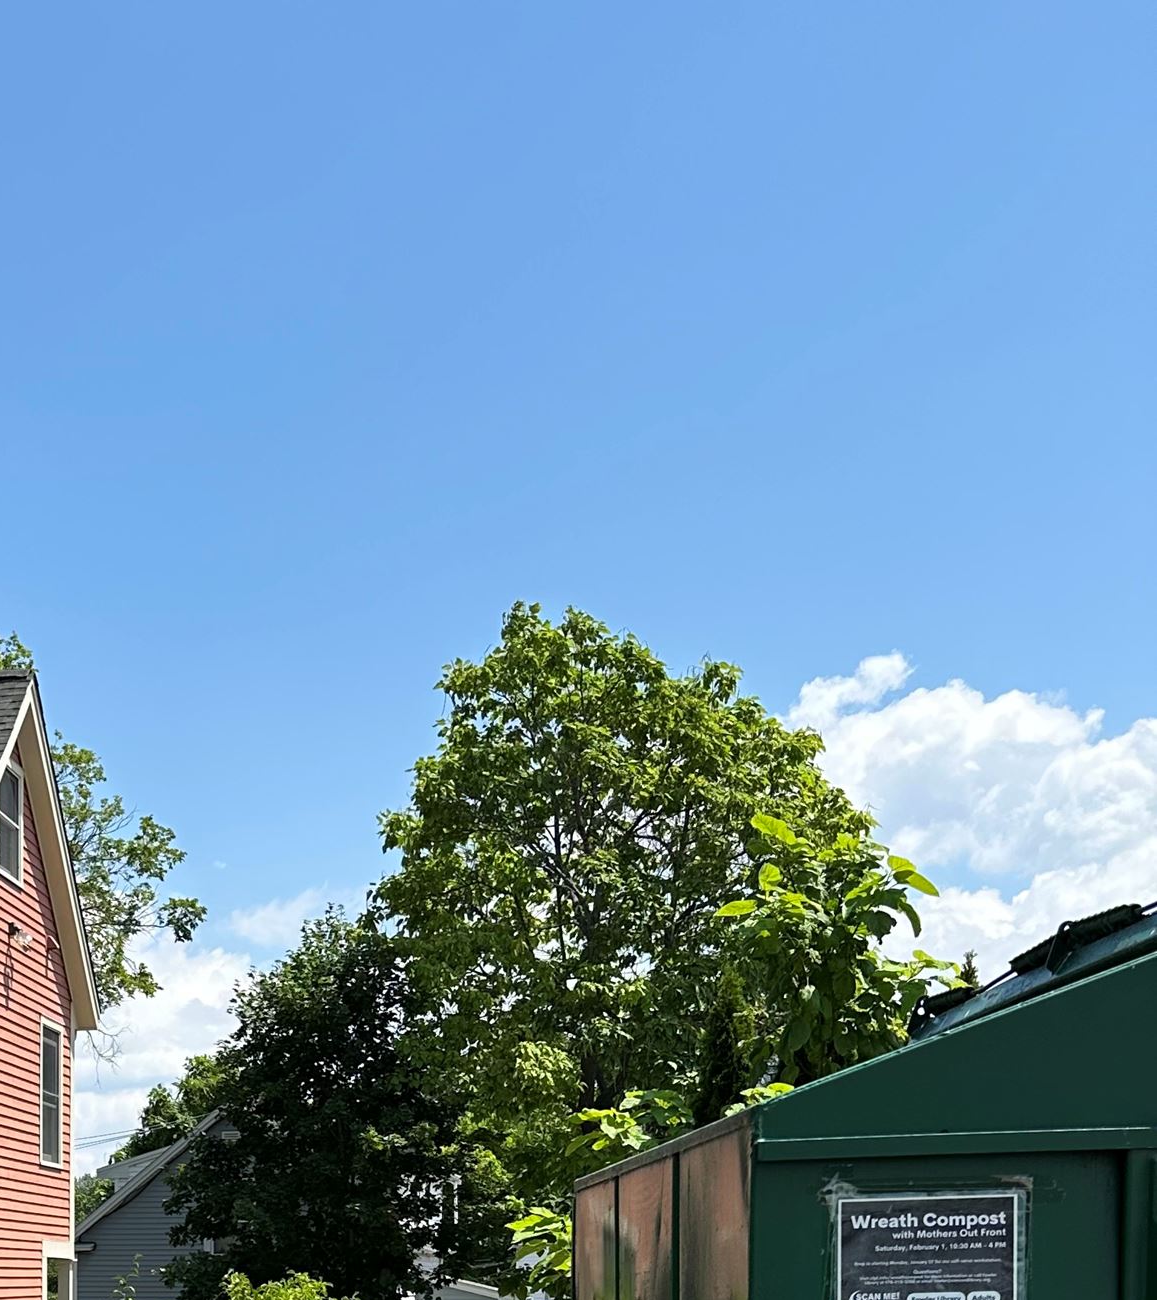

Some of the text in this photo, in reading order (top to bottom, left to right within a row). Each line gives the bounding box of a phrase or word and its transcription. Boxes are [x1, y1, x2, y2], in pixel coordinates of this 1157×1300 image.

[850, 1211, 1007, 1230] Wreath Compost
[892, 1227, 1007, 1240] with Mothers Out Front
[874, 1244, 908, 1253] Saturday,
[909, 1243, 940, 1252] February
[855, 1291, 900, 1300] SCAN ME!
